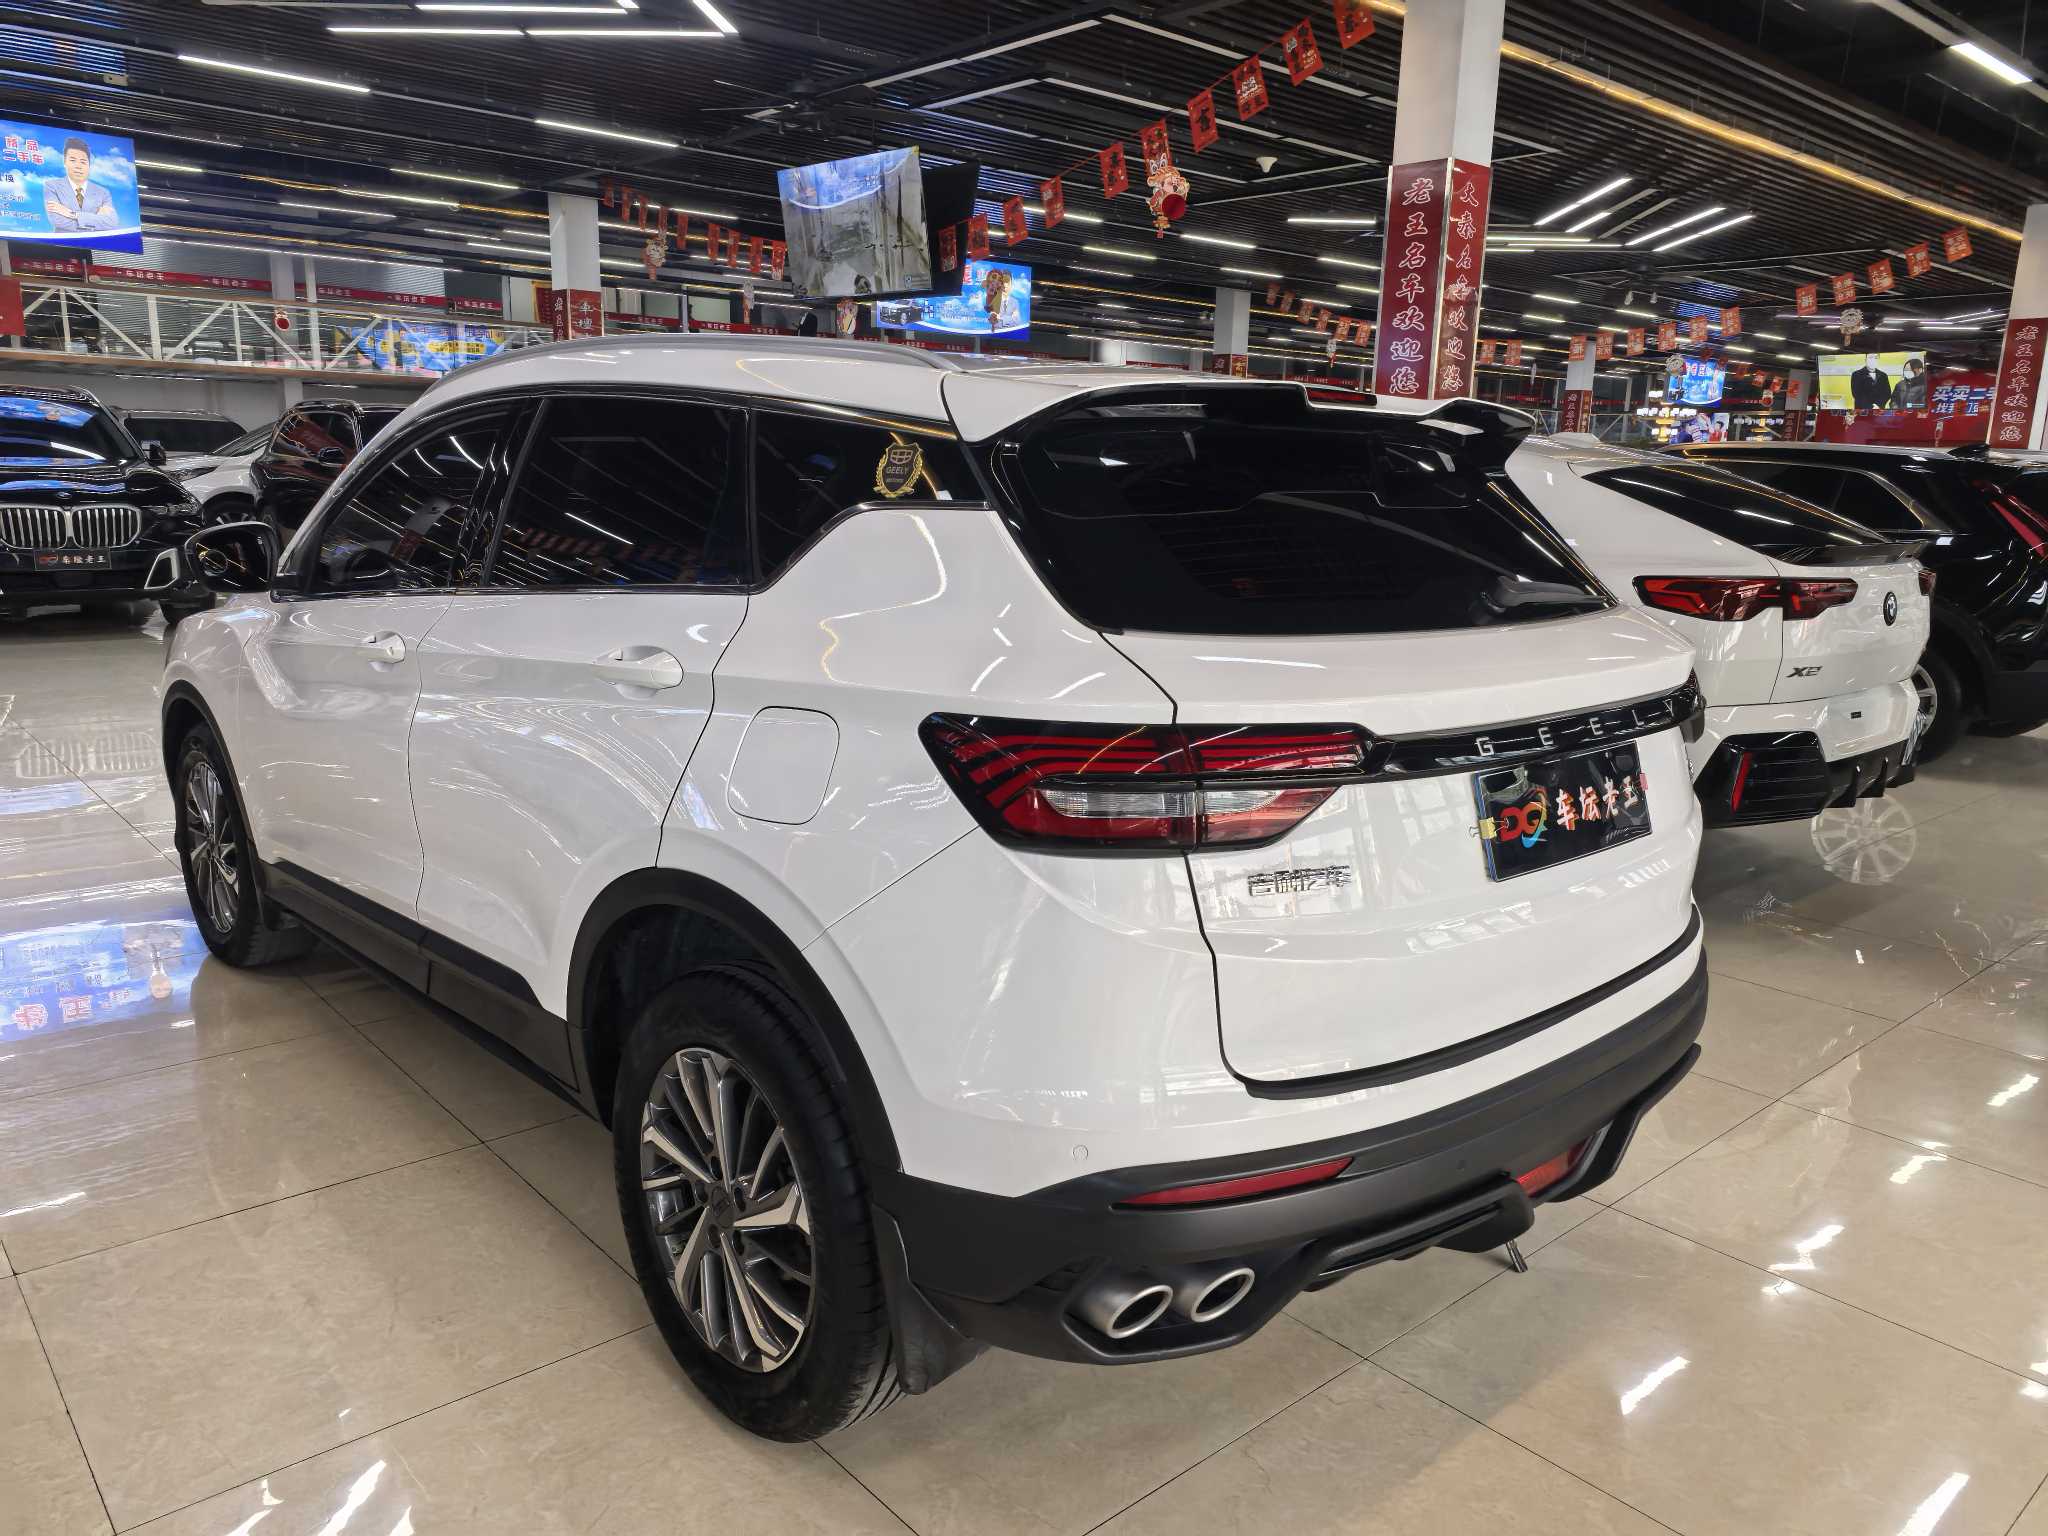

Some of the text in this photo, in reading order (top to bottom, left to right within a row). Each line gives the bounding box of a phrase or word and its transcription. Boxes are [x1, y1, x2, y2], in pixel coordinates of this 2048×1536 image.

[3, 149, 44, 165] 二手车
[1388, 177, 1434, 394] 老王名车欢迎您
[2000, 325, 2040, 441] 老王名车欢迎您
[1475, 698, 1676, 757] GEELY
[1556, 775, 1641, 832] 车坛老王
[1247, 865, 1352, 897] 吉利汽车
